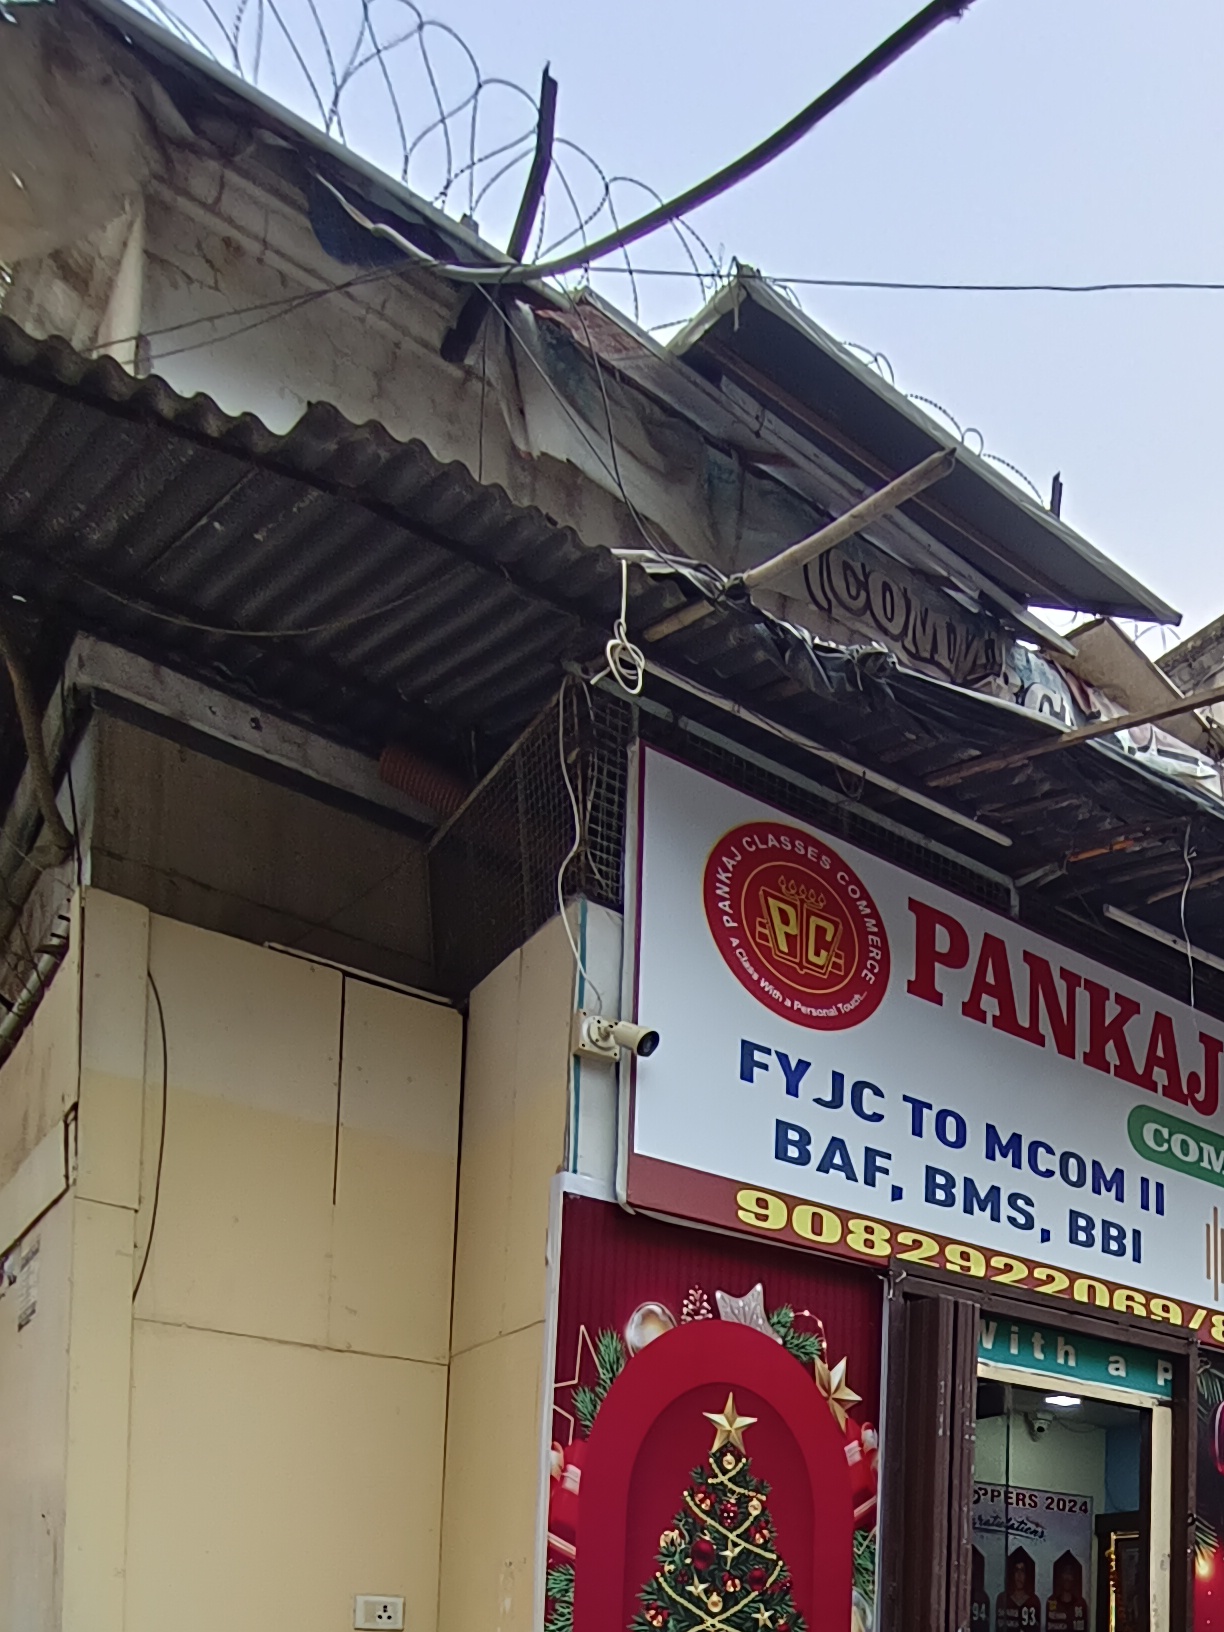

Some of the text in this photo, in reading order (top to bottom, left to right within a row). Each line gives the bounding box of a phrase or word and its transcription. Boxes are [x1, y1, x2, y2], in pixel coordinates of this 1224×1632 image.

[715, 833, 882, 984] PANKAJ CLASSES COMMERCE
[907, 897, 1223, 1116] PANKAJ
[774, 1118, 1143, 1264] BAF, BMS, BBI
[902, 1094, 967, 1149] TO
[985, 1122, 1125, 1203] MCOM
[1140, 1176, 1165, 1217] II
[1045, 1496, 1089, 1515] 2024
[1021, 1606, 1037, 1627] 93
